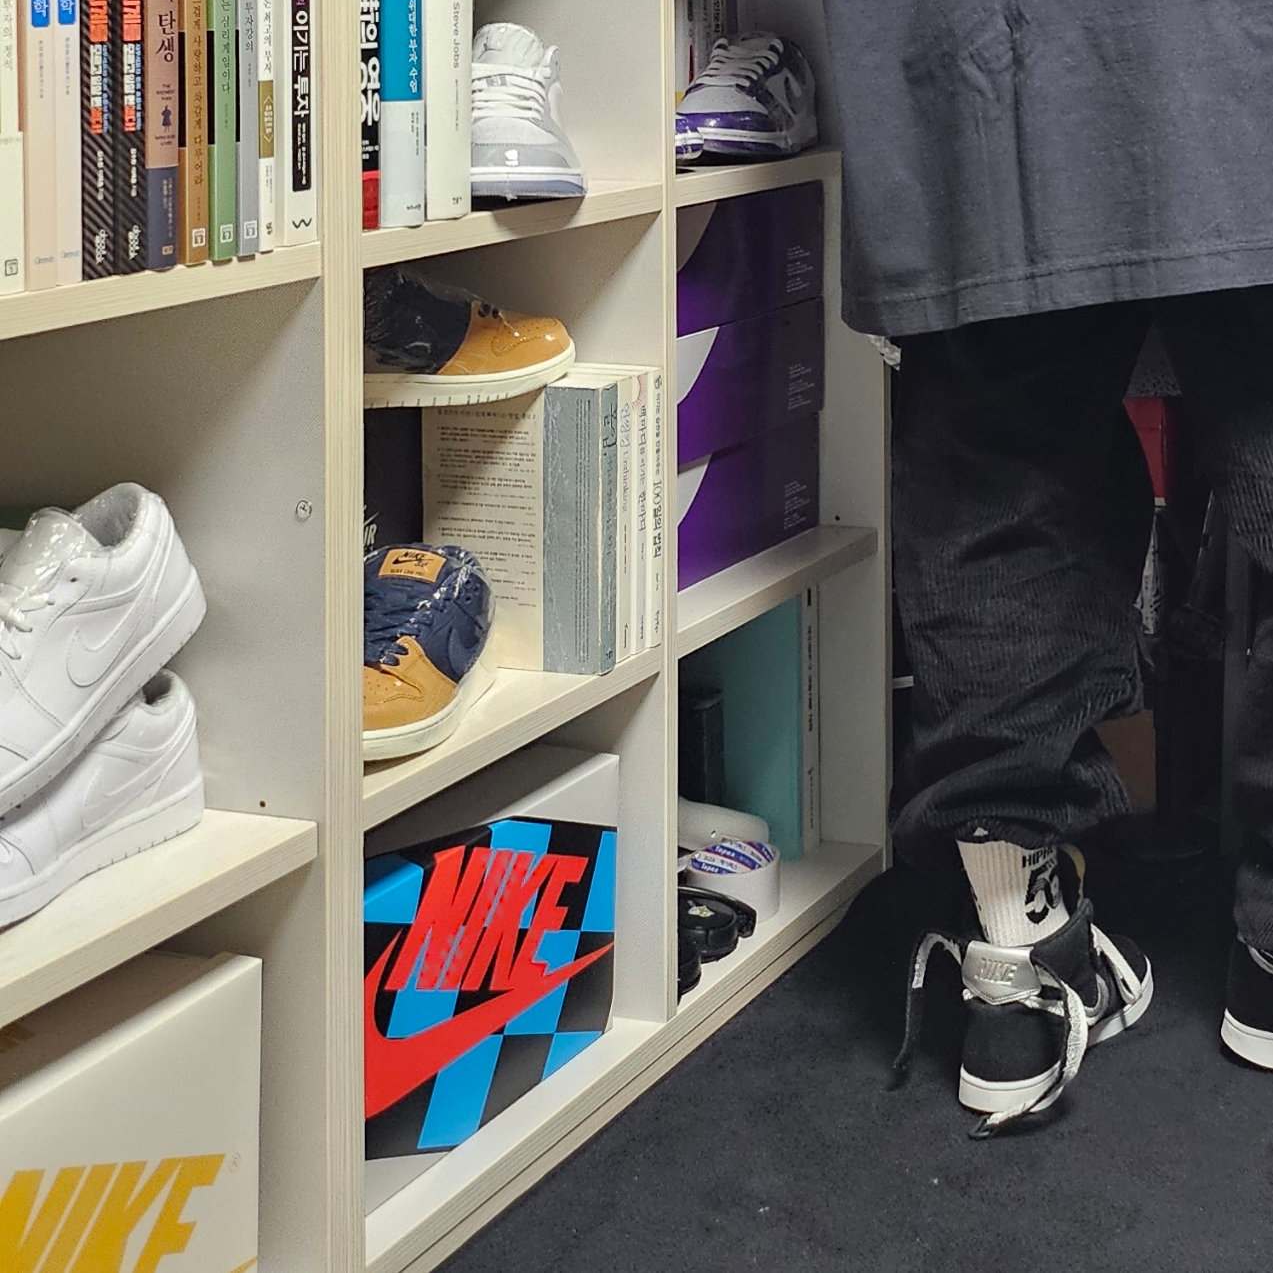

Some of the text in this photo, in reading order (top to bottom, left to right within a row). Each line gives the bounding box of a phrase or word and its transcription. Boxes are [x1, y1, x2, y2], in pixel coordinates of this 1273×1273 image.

[155, 10, 176, 64] 탄생
[244, 0, 255, 54] 투자강의
[293, 9, 309, 73] 이기는
[452, 1, 461, 69] Steve Jobs
[89, 43, 104, 73] 모르고
[122, 43, 137, 73] 모르고
[192, 35, 203, 87] 사랑하고
[221, 14, 232, 96] 심리게임이다
[408, 38, 418, 65] 부자
[89, 73, 104, 95] 일할
[122, 73, 137, 95] 일할
[293, 74, 309, 118] 투자
[360, 56, 381, 126] 영웅
[408, 66, 419, 94] 수업
[193, 92, 204, 131] 차갑게
[193, 135, 205, 187] 다루어라
[621, 451, 630, 513] Unthinking
[639, 457, 647, 486] 이기는
[638, 490, 647, 532] 한마디
[652, 479, 663, 531] 100일의
[400, 551, 426, 561] NIKE
[652, 532, 662, 559] 법칙
[383, 844, 590, 992] NIKE
[975, 958, 1018, 984] NIKE
[0, 1153, 226, 1273] NIKE
